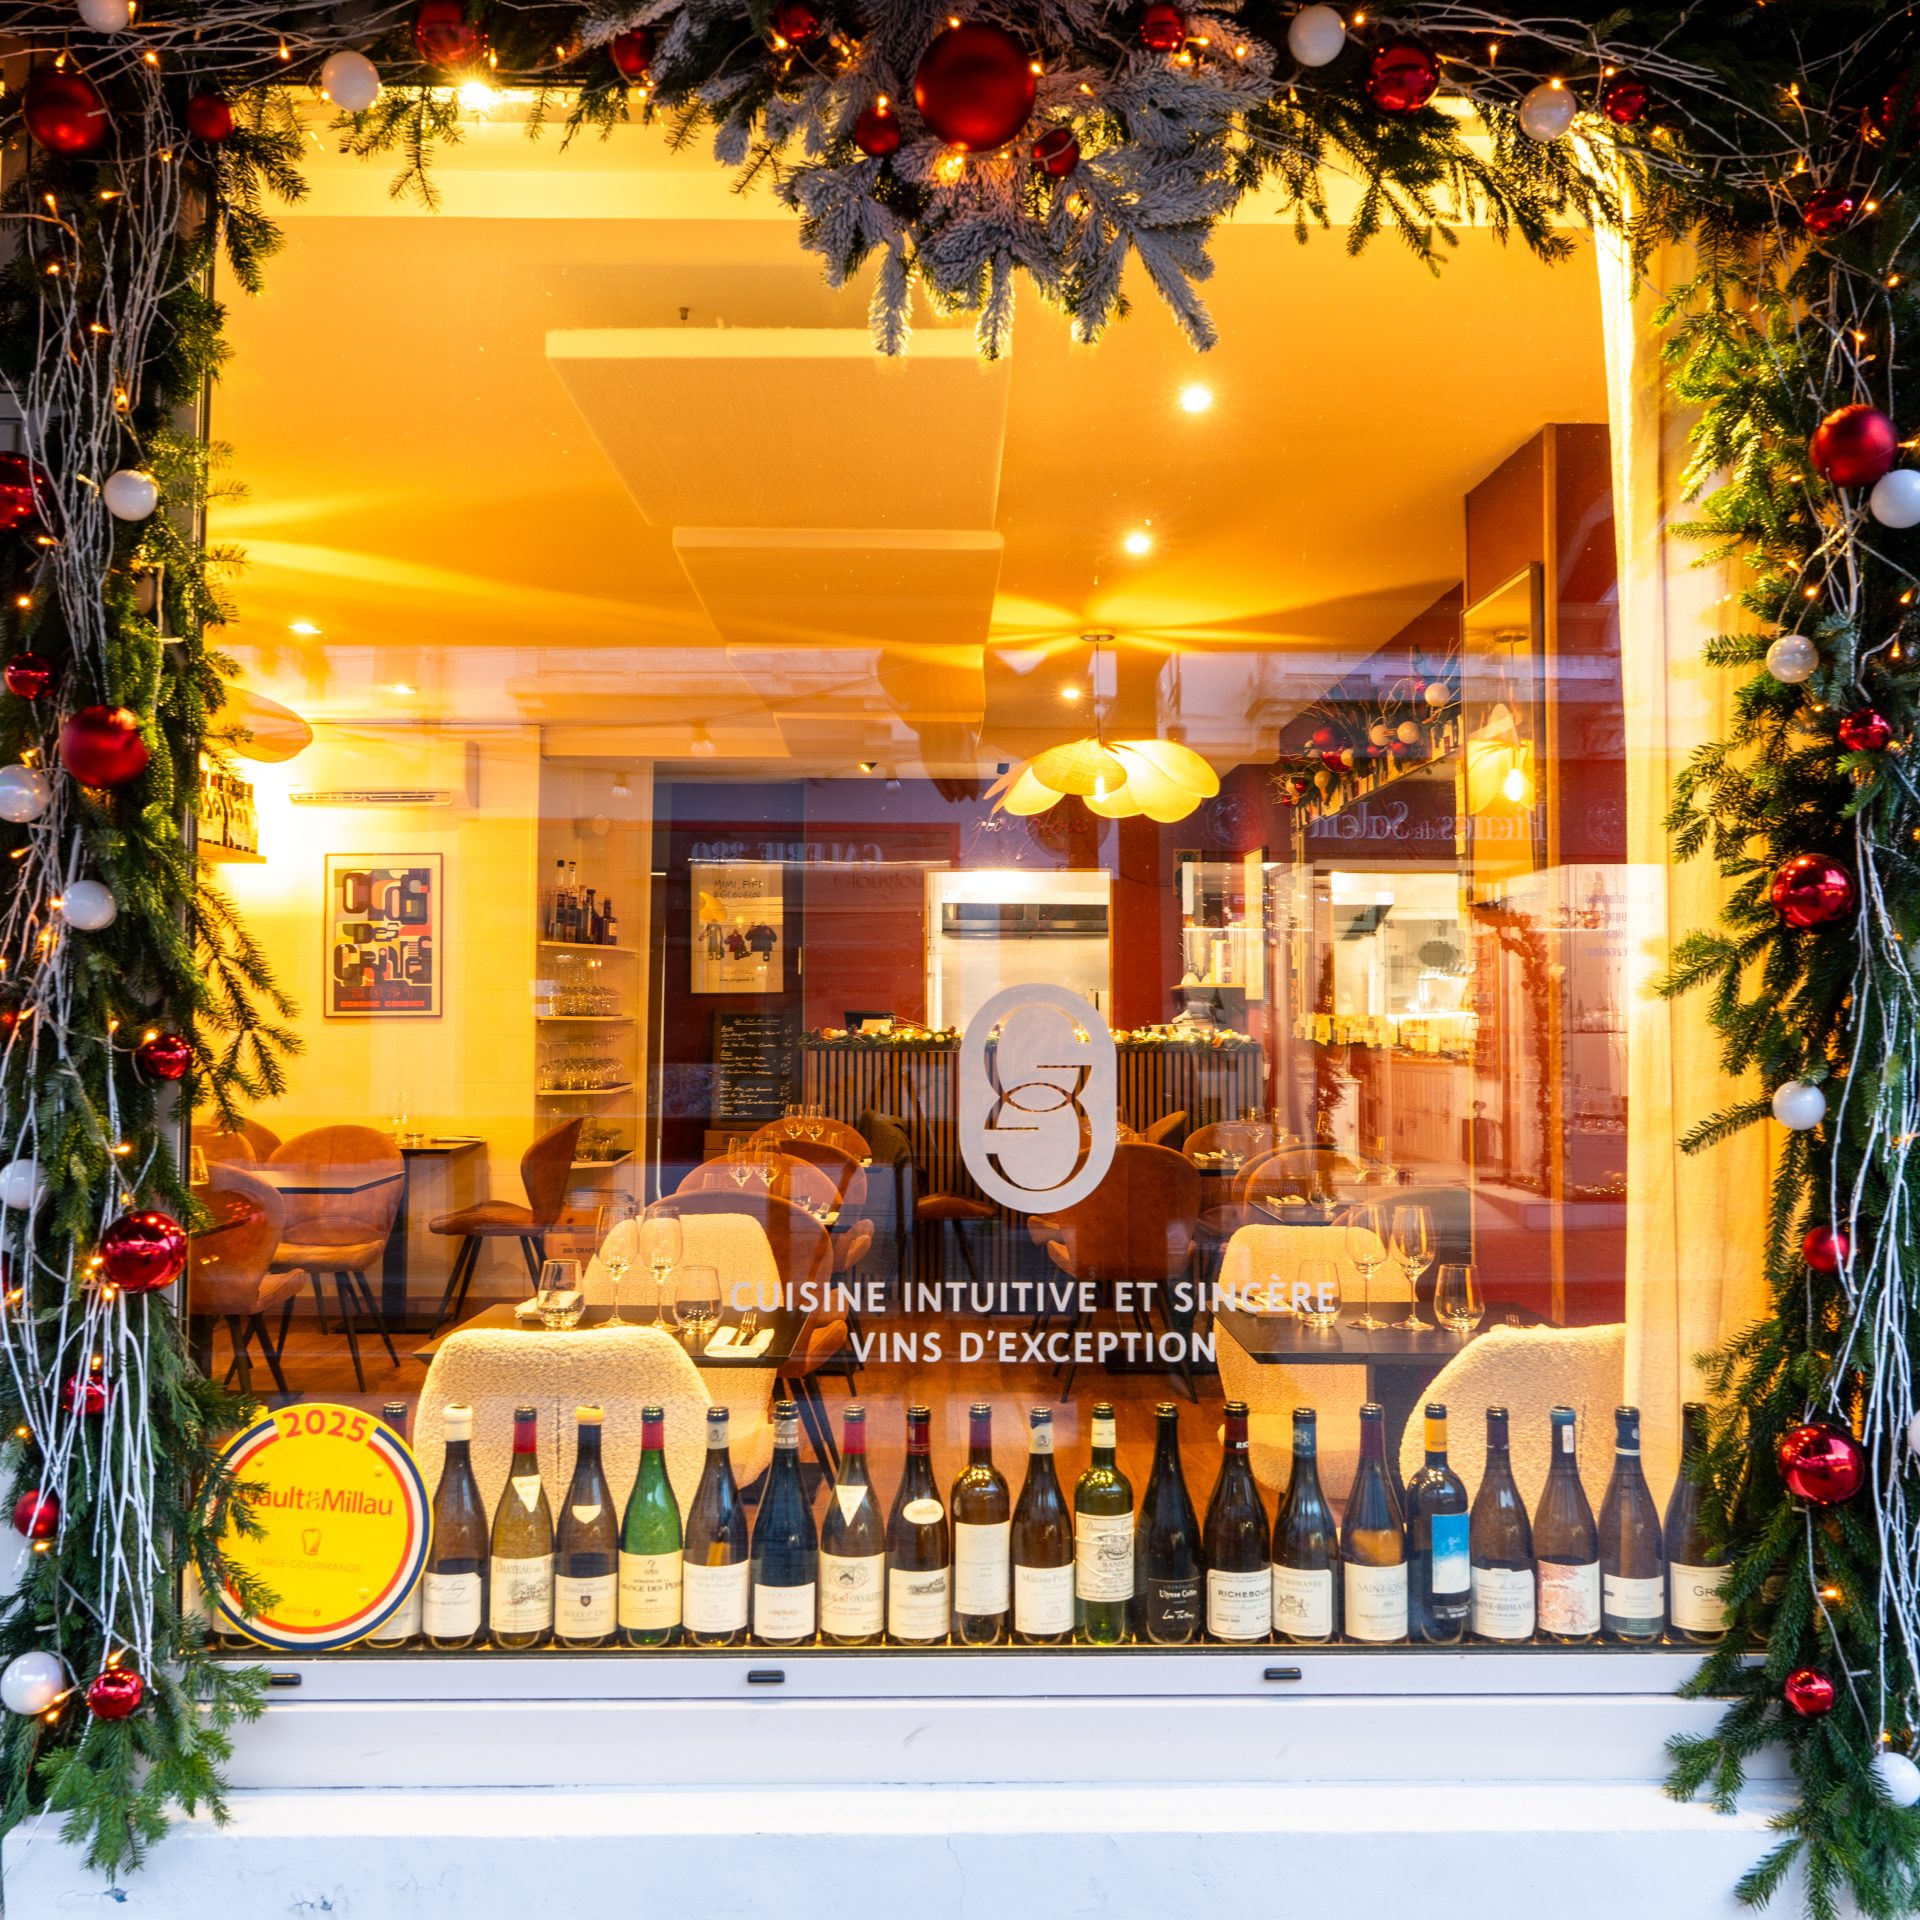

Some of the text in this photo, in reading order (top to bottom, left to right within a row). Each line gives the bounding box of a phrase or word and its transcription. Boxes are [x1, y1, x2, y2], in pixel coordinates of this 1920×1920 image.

[731, 1273, 1335, 1313] CUISINE INTUITIVE ET SINCÈRE
[850, 1331, 1217, 1363] VINS D'EXCEPTION
[282, 1409, 368, 1443] 2025
[254, 1557, 363, 1574] TABLE GOURMANDE
